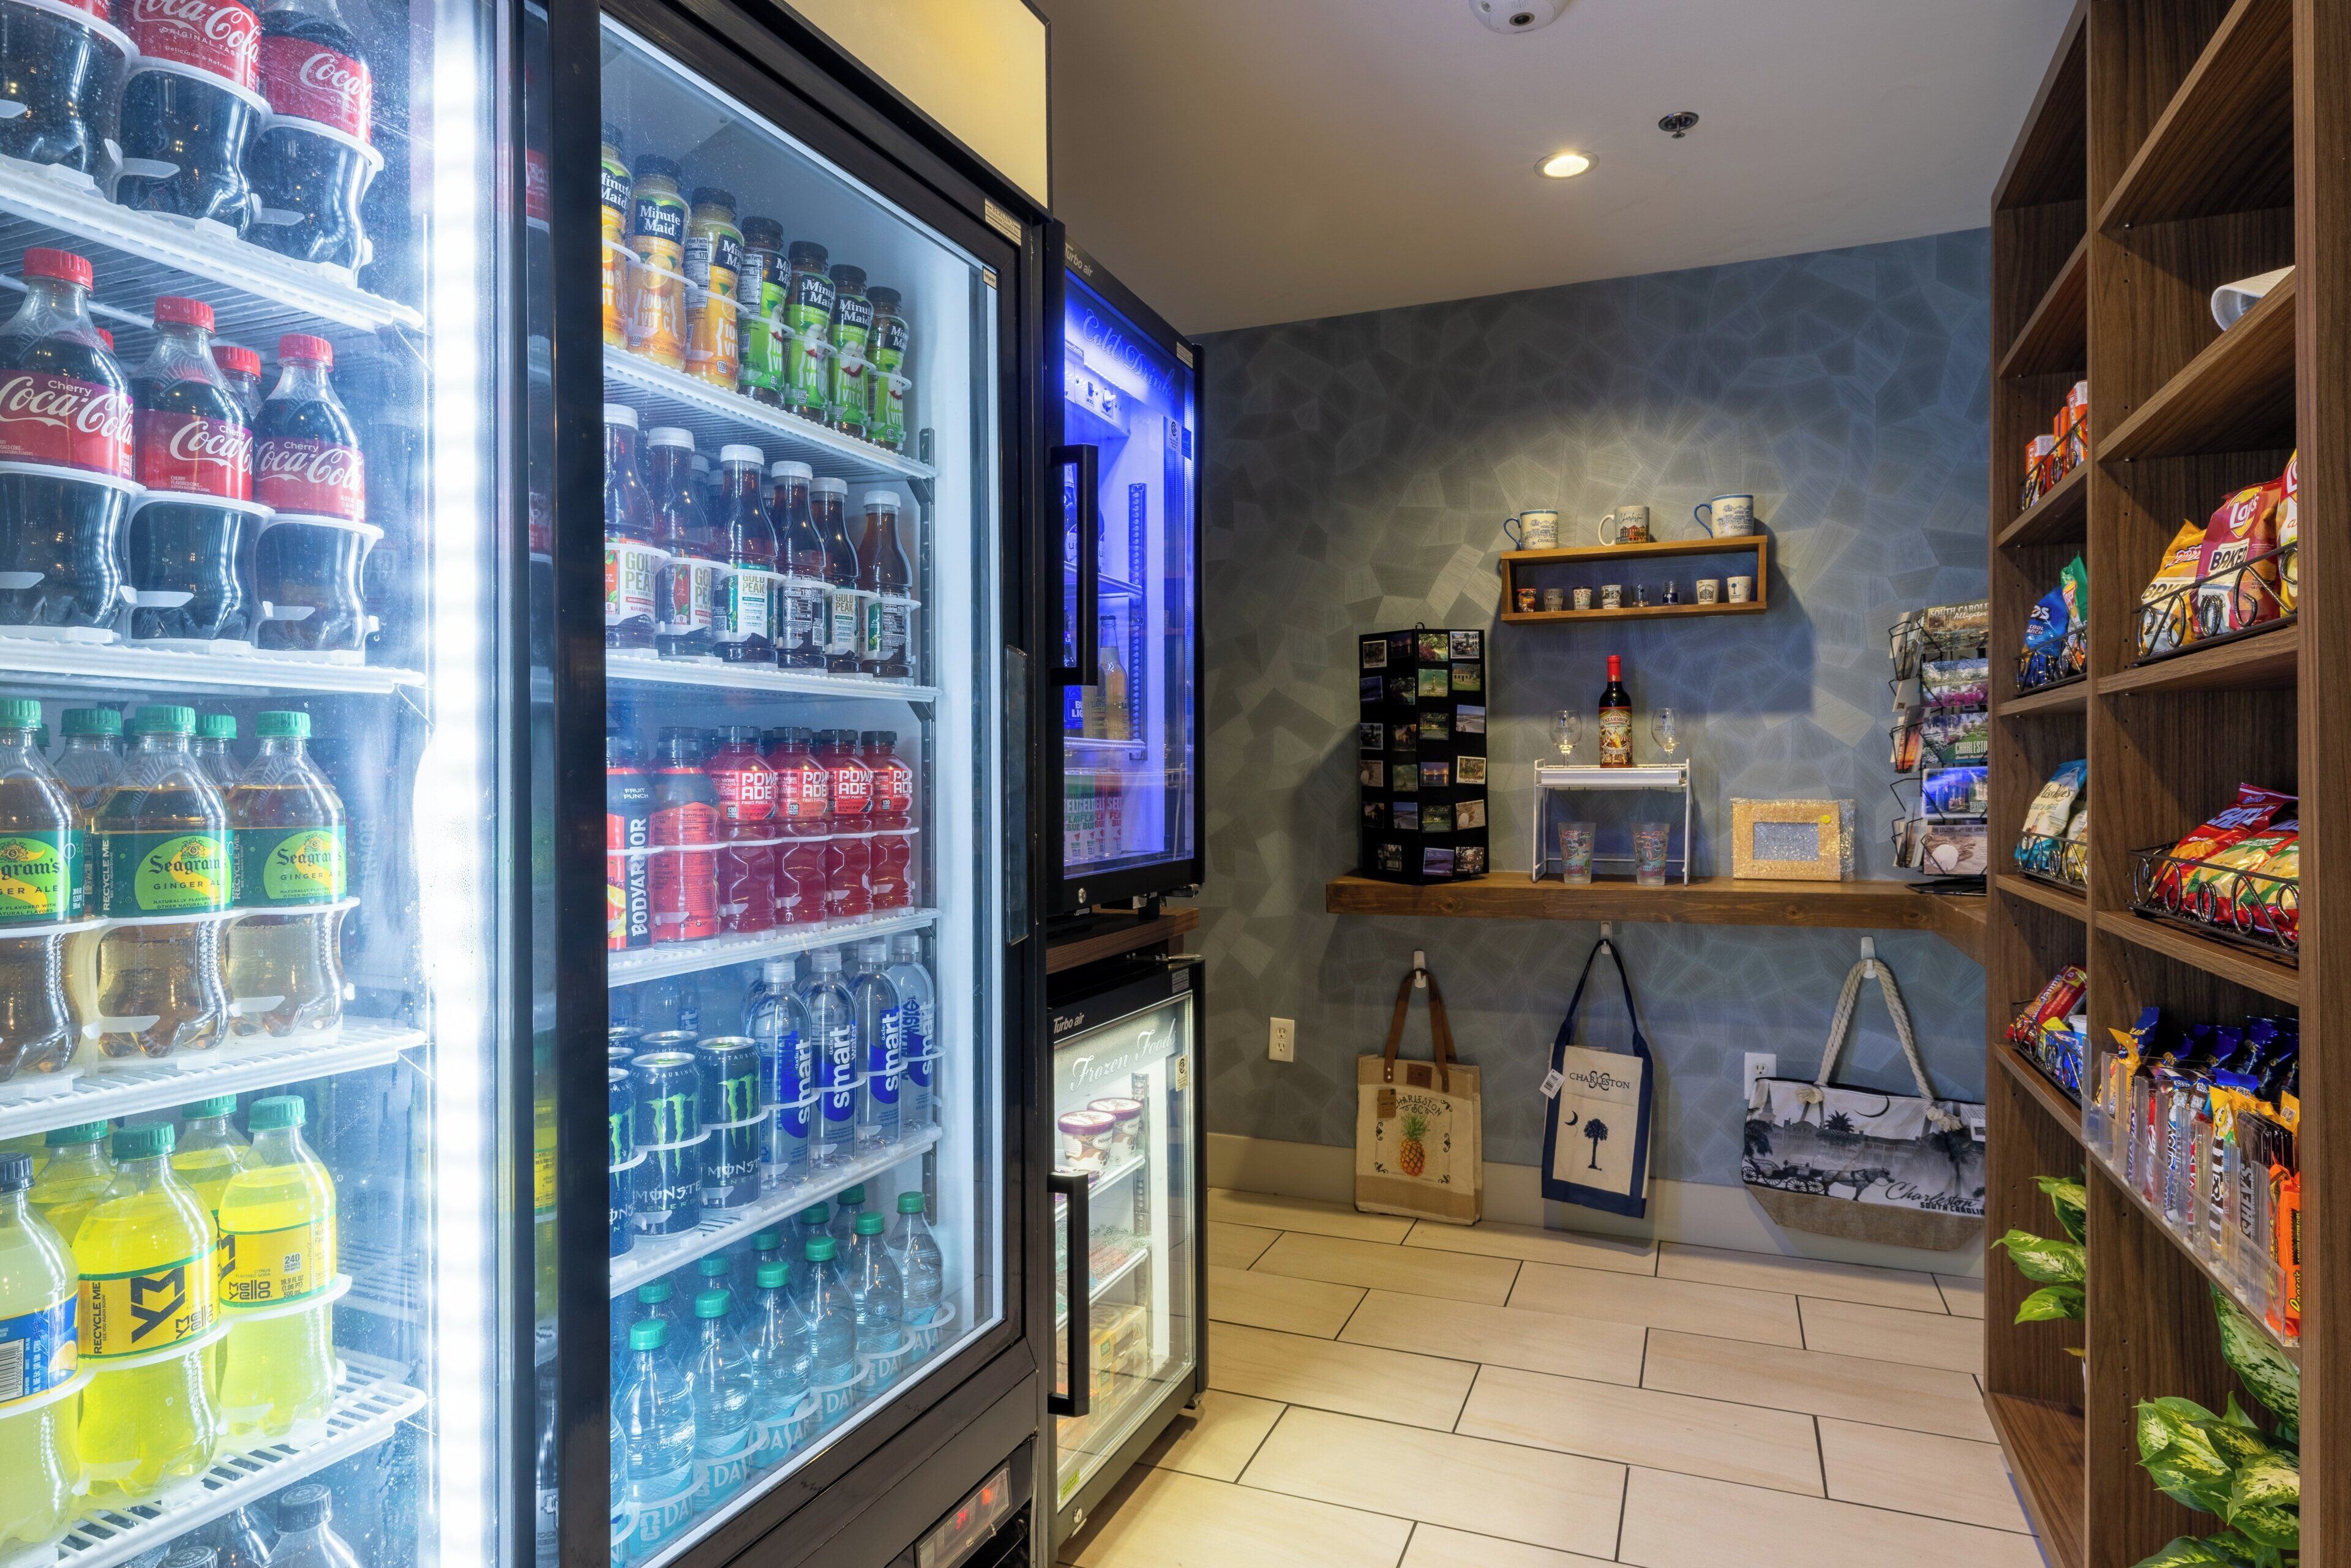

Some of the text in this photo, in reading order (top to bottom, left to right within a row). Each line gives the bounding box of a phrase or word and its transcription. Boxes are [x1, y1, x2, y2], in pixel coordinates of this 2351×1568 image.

[159, 26, 214, 47] ORIGINAL
[165, 45, 200, 59] Delicious
[601, 173, 631, 199] inute
[601, 187, 628, 211] Maid
[640, 205, 681, 226] Minute
[644, 218, 675, 236] Maid
[722, 239, 743, 257] Min
[1065, 242, 1093, 277] Turbo air
[844, 310, 871, 326] Maid
[1083, 308, 1176, 399] Cold Drinks
[48, 380, 92, 397] Cherry
[842, 388, 856, 405] VIT
[0, 376, 134, 446] Coca-Cola
[169, 421, 253, 476] Coca-C
[283, 441, 319, 452] Cherry
[2229, 494, 2260, 529] Lay's
[625, 550, 655, 575] GOLD
[2210, 546, 2249, 572] BAKED
[694, 567, 712, 589] GOL
[742, 574, 765, 583] GOLD
[742, 582, 765, 593] PEAK
[835, 602, 853, 613] PEAK
[836, 594, 854, 604] GOLD
[1930, 607, 1956, 618] SOUTH
[1602, 716, 1629, 725] FREAKSHOW
[1955, 740, 1988, 756] CHARLESTO
[741, 786, 773, 800] ADE
[838, 782, 868, 795] ADE
[102, 839, 110, 857] ME
[233, 833, 240, 851] ME
[1, 858, 63, 880] gram's
[154, 880, 204, 890] GINGER
[1054, 1012, 1086, 1034] Turbo air
[727, 1051, 756, 1061] TAURIN
[882, 1014, 901, 1092] smart
[1070, 1018, 1177, 1092] Frozen Foods
[655, 1068, 694, 1079] TAURINE
[829, 1024, 850, 1109] smart
[795, 1039, 811, 1125] smart
[1569, 1072, 1630, 1090] CHARLESTON
[1411, 1103, 1423, 1115] SC
[708, 1156, 760, 1179] MONST
[632, 1179, 702, 1204] MONSTE
[1885, 1181, 1981, 1207] Charleston
[647, 1198, 697, 1212] ENERG
[1920, 1201, 1948, 1211] SOUTH
[2240, 1163, 2252, 1240] SHEY'S
[285, 1253, 300, 1264] 240
[282, 1285, 294, 1293] (1.06
[92, 1281, 102, 1354] RECYCLE ME
